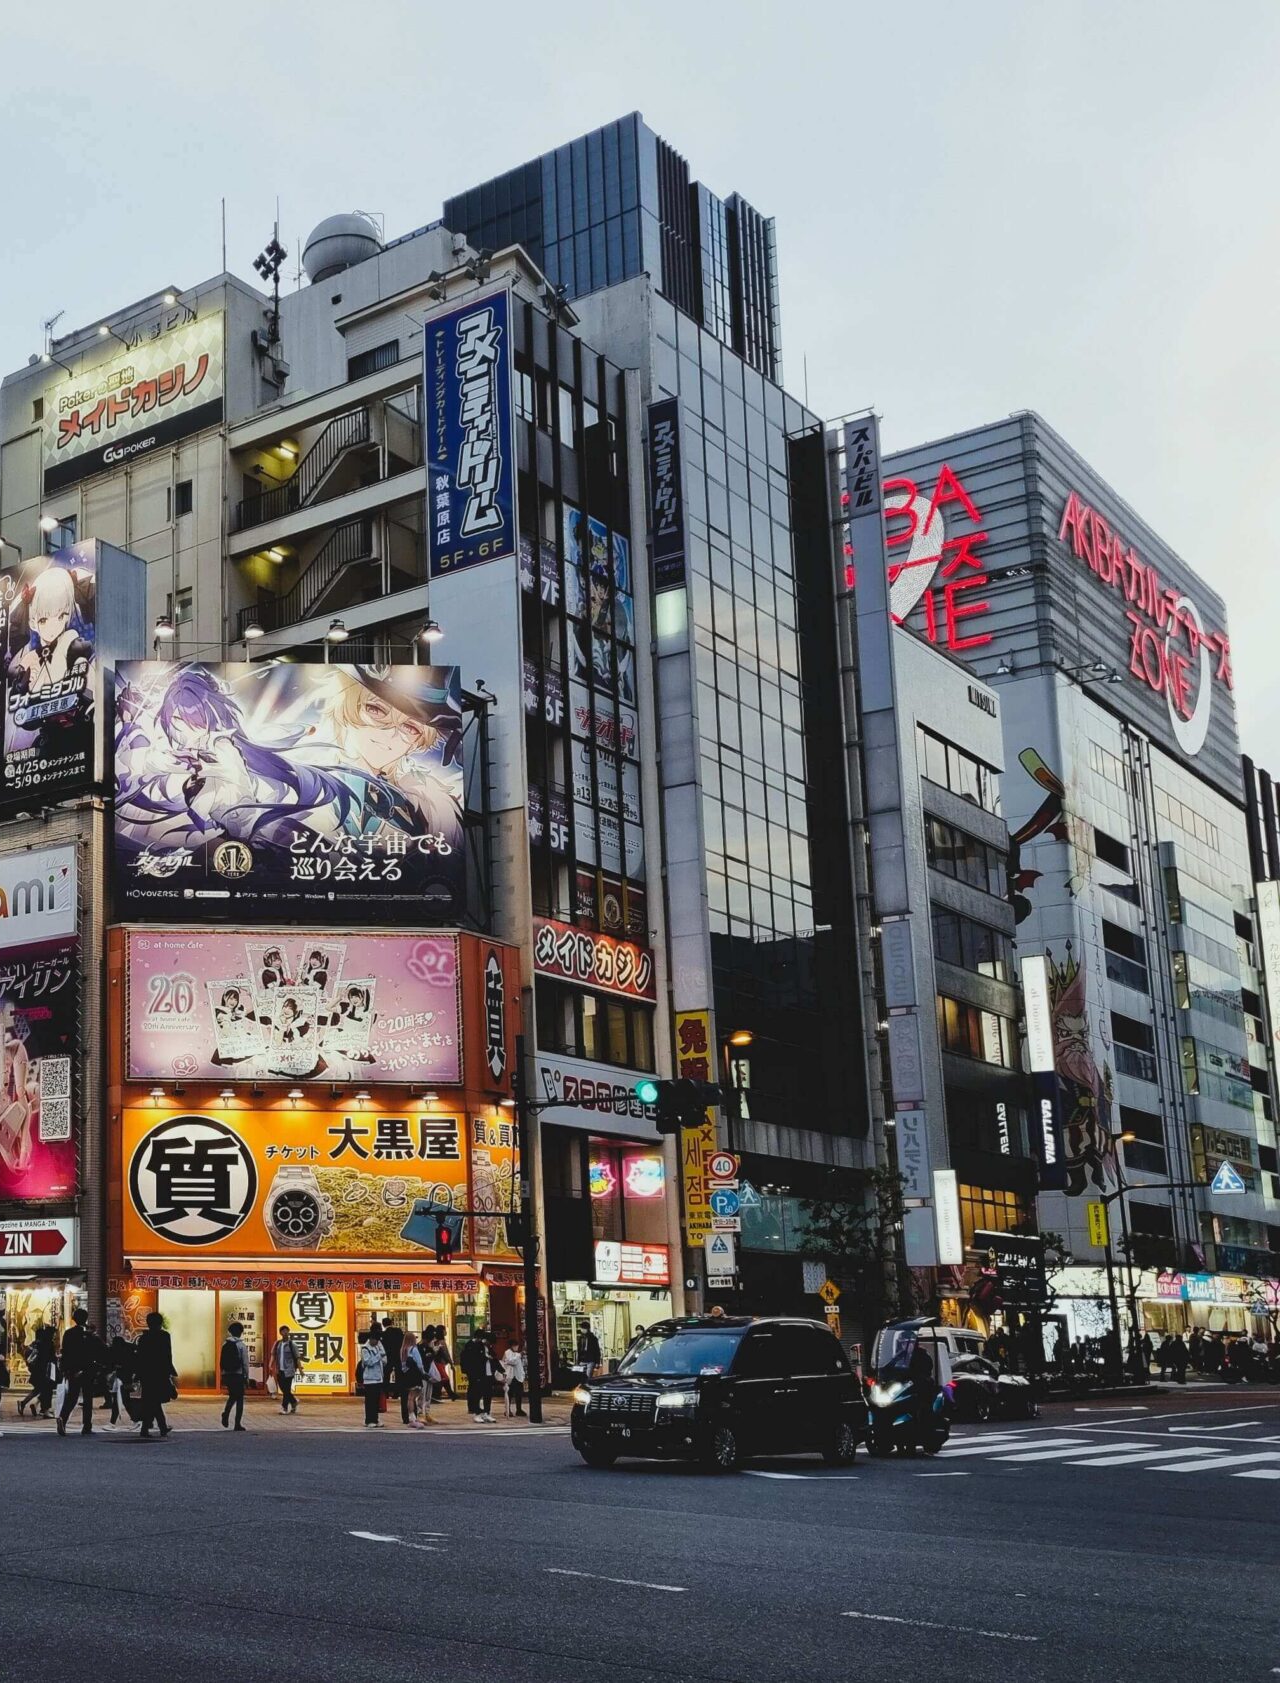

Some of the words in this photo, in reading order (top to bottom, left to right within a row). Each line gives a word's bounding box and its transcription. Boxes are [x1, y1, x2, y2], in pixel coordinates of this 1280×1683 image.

[57, 353, 210, 449] メイドカジノ
[435, 474, 452, 546] 秋葉原店
[541, 575, 561, 607] 7F
[1126, 610, 1194, 721] ZONE
[545, 695, 565, 727] 6F
[15, 761, 39, 776] 4/25
[288, 830, 453, 856] どんな宇宙でも
[549, 822, 570, 852] 5F
[289, 857, 403, 882] 巡り会える
[536, 925, 652, 994] メイドカジノ
[148, 975, 194, 1015] 20
[327, 1117, 461, 1161] 大黒屋
[1040, 1098, 1057, 1166] GALLERIA
[265, 1145, 320, 1161] チケット
[715, 1157, 731, 1172] 40
[143, 1136, 245, 1230] 質
[715, 1195, 728, 1216] P
[5, 1232, 32, 1254] ZIN
[135, 1274, 183, 1288] 高価買取
[429, 1278, 479, 1292] 無料査定
[295, 1291, 329, 1325] 質
